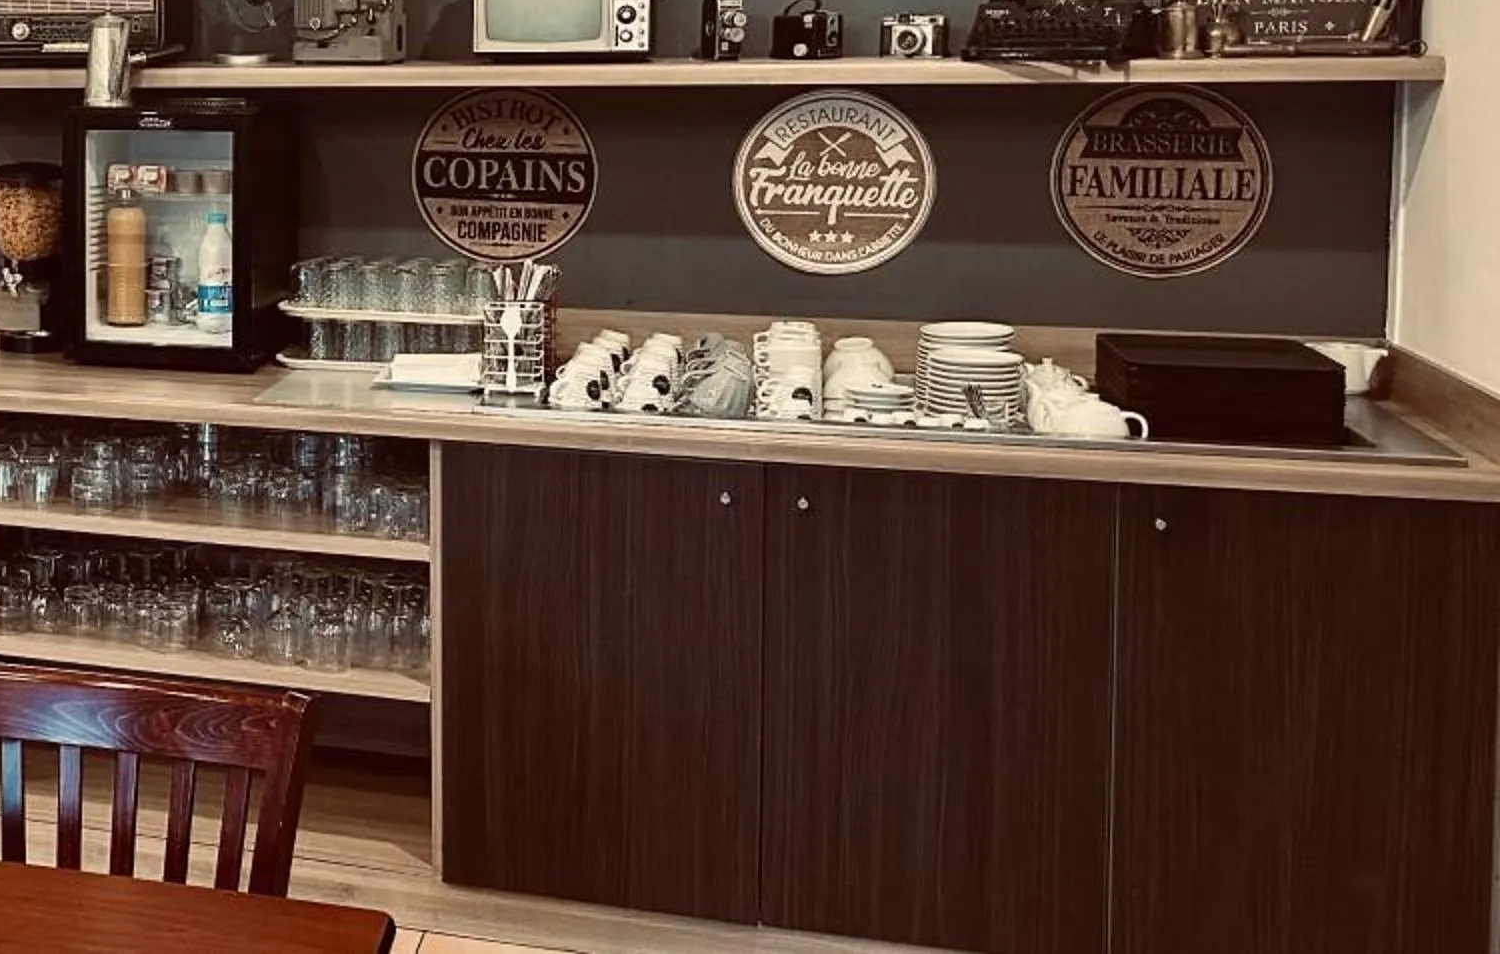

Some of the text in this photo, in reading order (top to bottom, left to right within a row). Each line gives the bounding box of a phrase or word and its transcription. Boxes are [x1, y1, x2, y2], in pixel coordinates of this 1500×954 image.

[1253, 20, 1309, 35] PARIS
[449, 97, 563, 134] BISTROT
[773, 106, 898, 142] RESTAURANT
[513, 127, 547, 151] les
[1093, 131, 1234, 156] BRASSERIE
[422, 156, 587, 193] COPAINS
[785, 150, 882, 181] La bonne
[749, 166, 920, 225] Franquette
[1067, 165, 1257, 202] FAMILIALE
[457, 220, 548, 243] COMPAGNIE
[1149, 253, 1165, 265] DE
